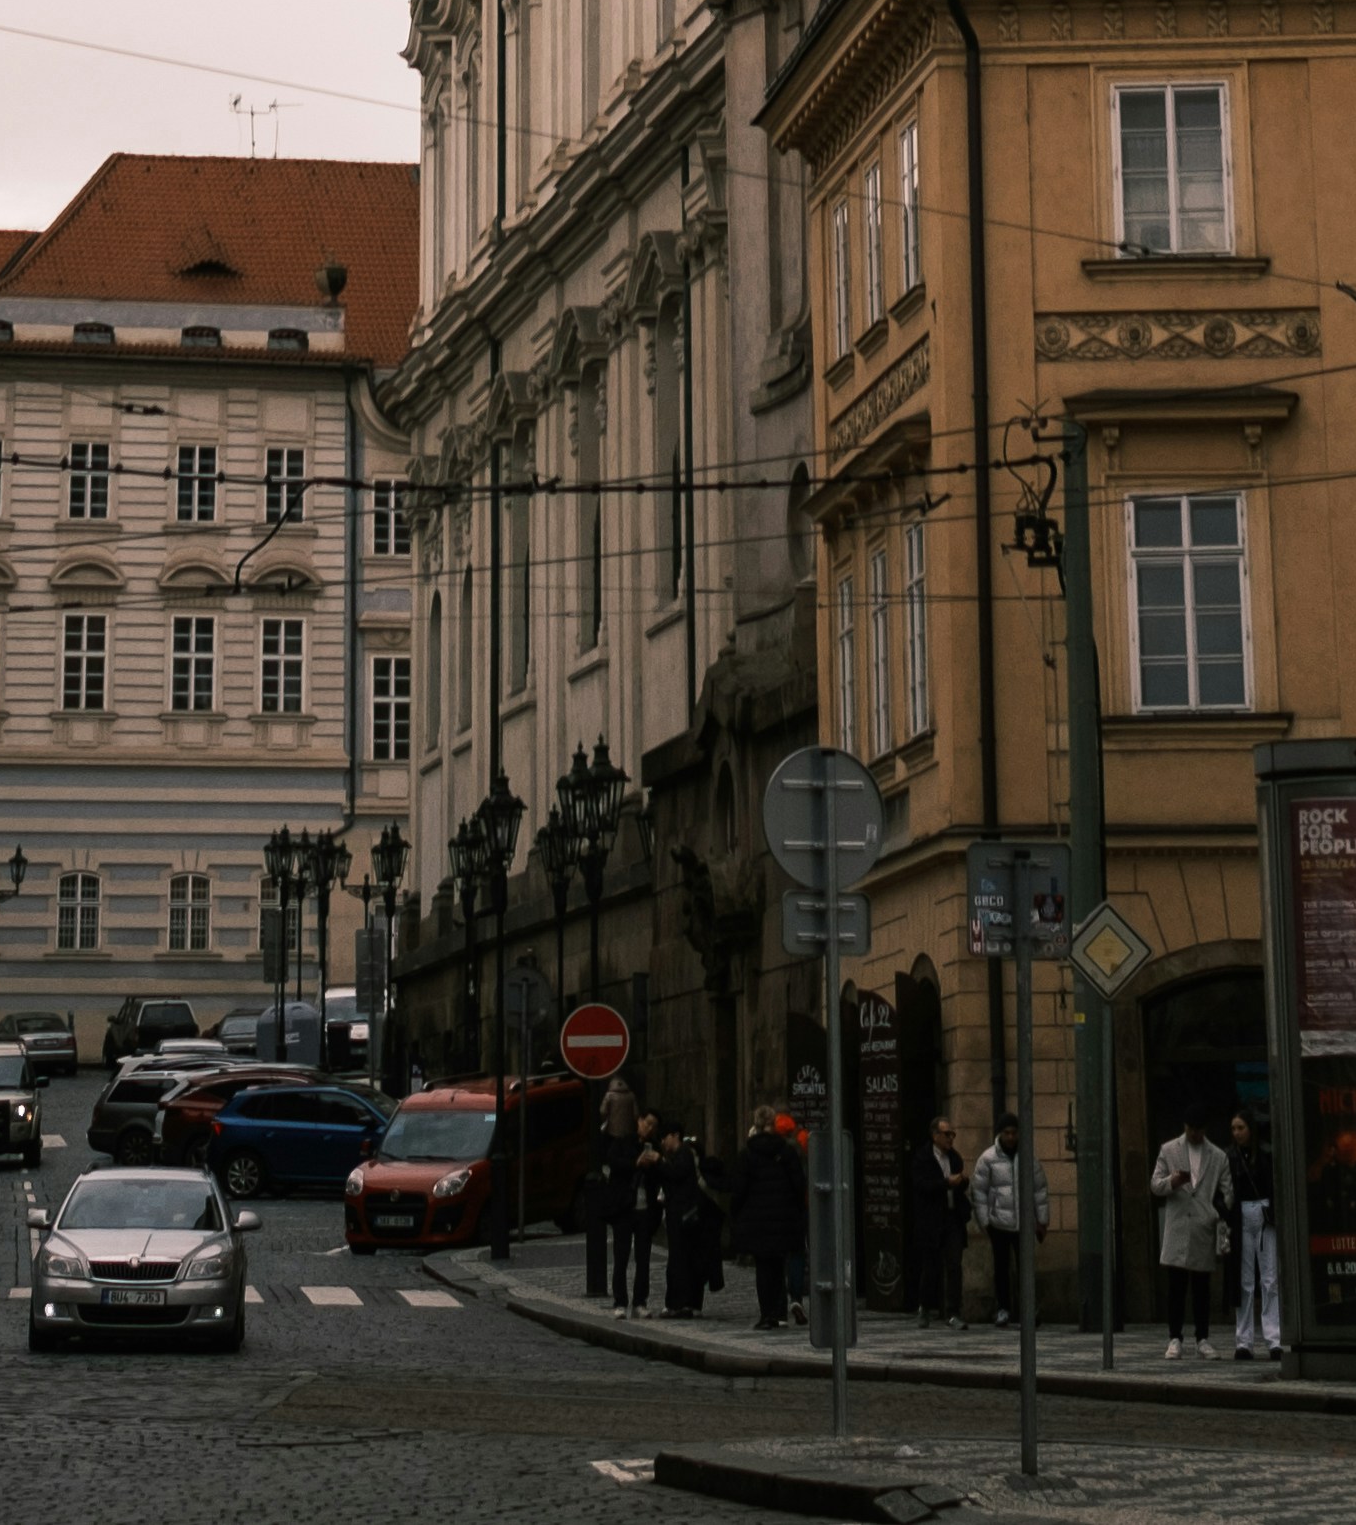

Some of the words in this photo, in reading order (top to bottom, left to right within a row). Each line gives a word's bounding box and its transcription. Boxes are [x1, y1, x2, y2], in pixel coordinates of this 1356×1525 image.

[1299, 808, 1349, 824] ROCK
[1299, 825, 1333, 839] FOR
[866, 1073, 899, 1094] SALADS
